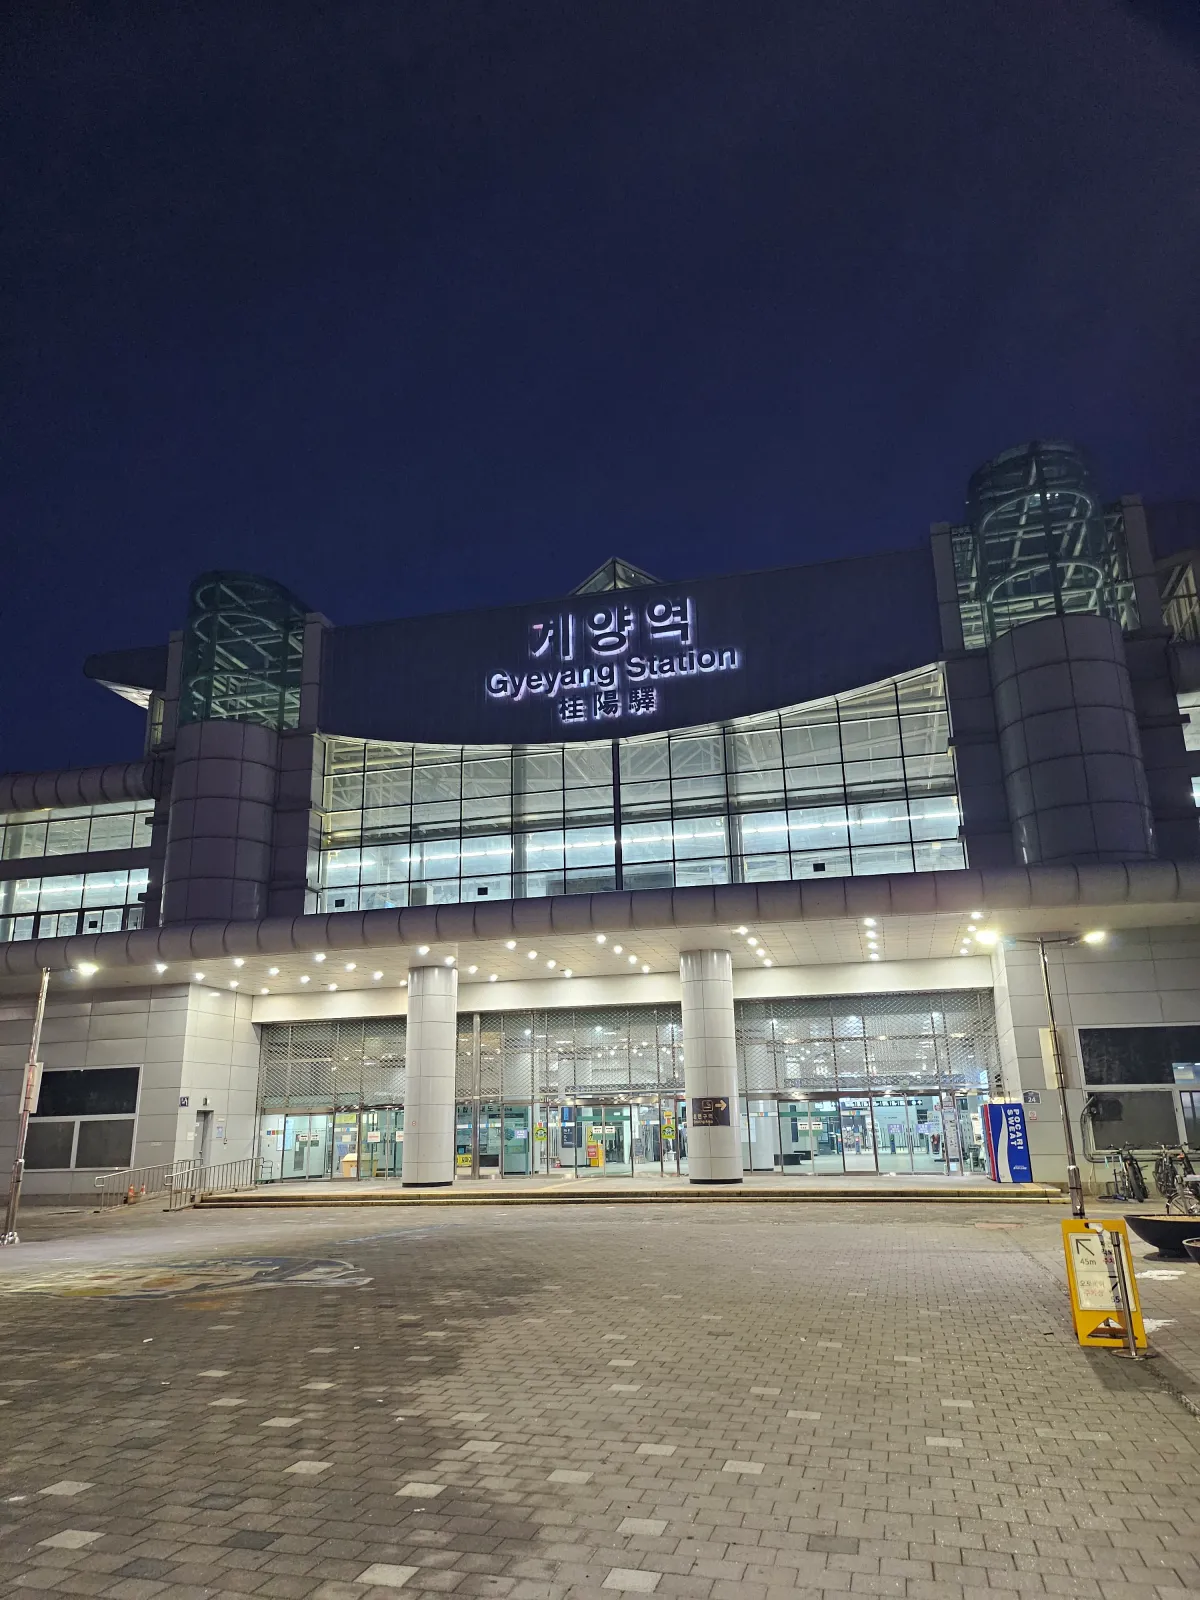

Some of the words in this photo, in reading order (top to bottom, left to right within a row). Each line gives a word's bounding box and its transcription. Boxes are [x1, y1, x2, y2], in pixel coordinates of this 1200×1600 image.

[530, 596, 692, 660] 계양역
[486, 662, 616, 701] Gyeyang
[626, 645, 738, 681] Station
[1007, 1109, 1017, 1146] SWEAT
[1013, 1109, 1024, 1149] POCARI
